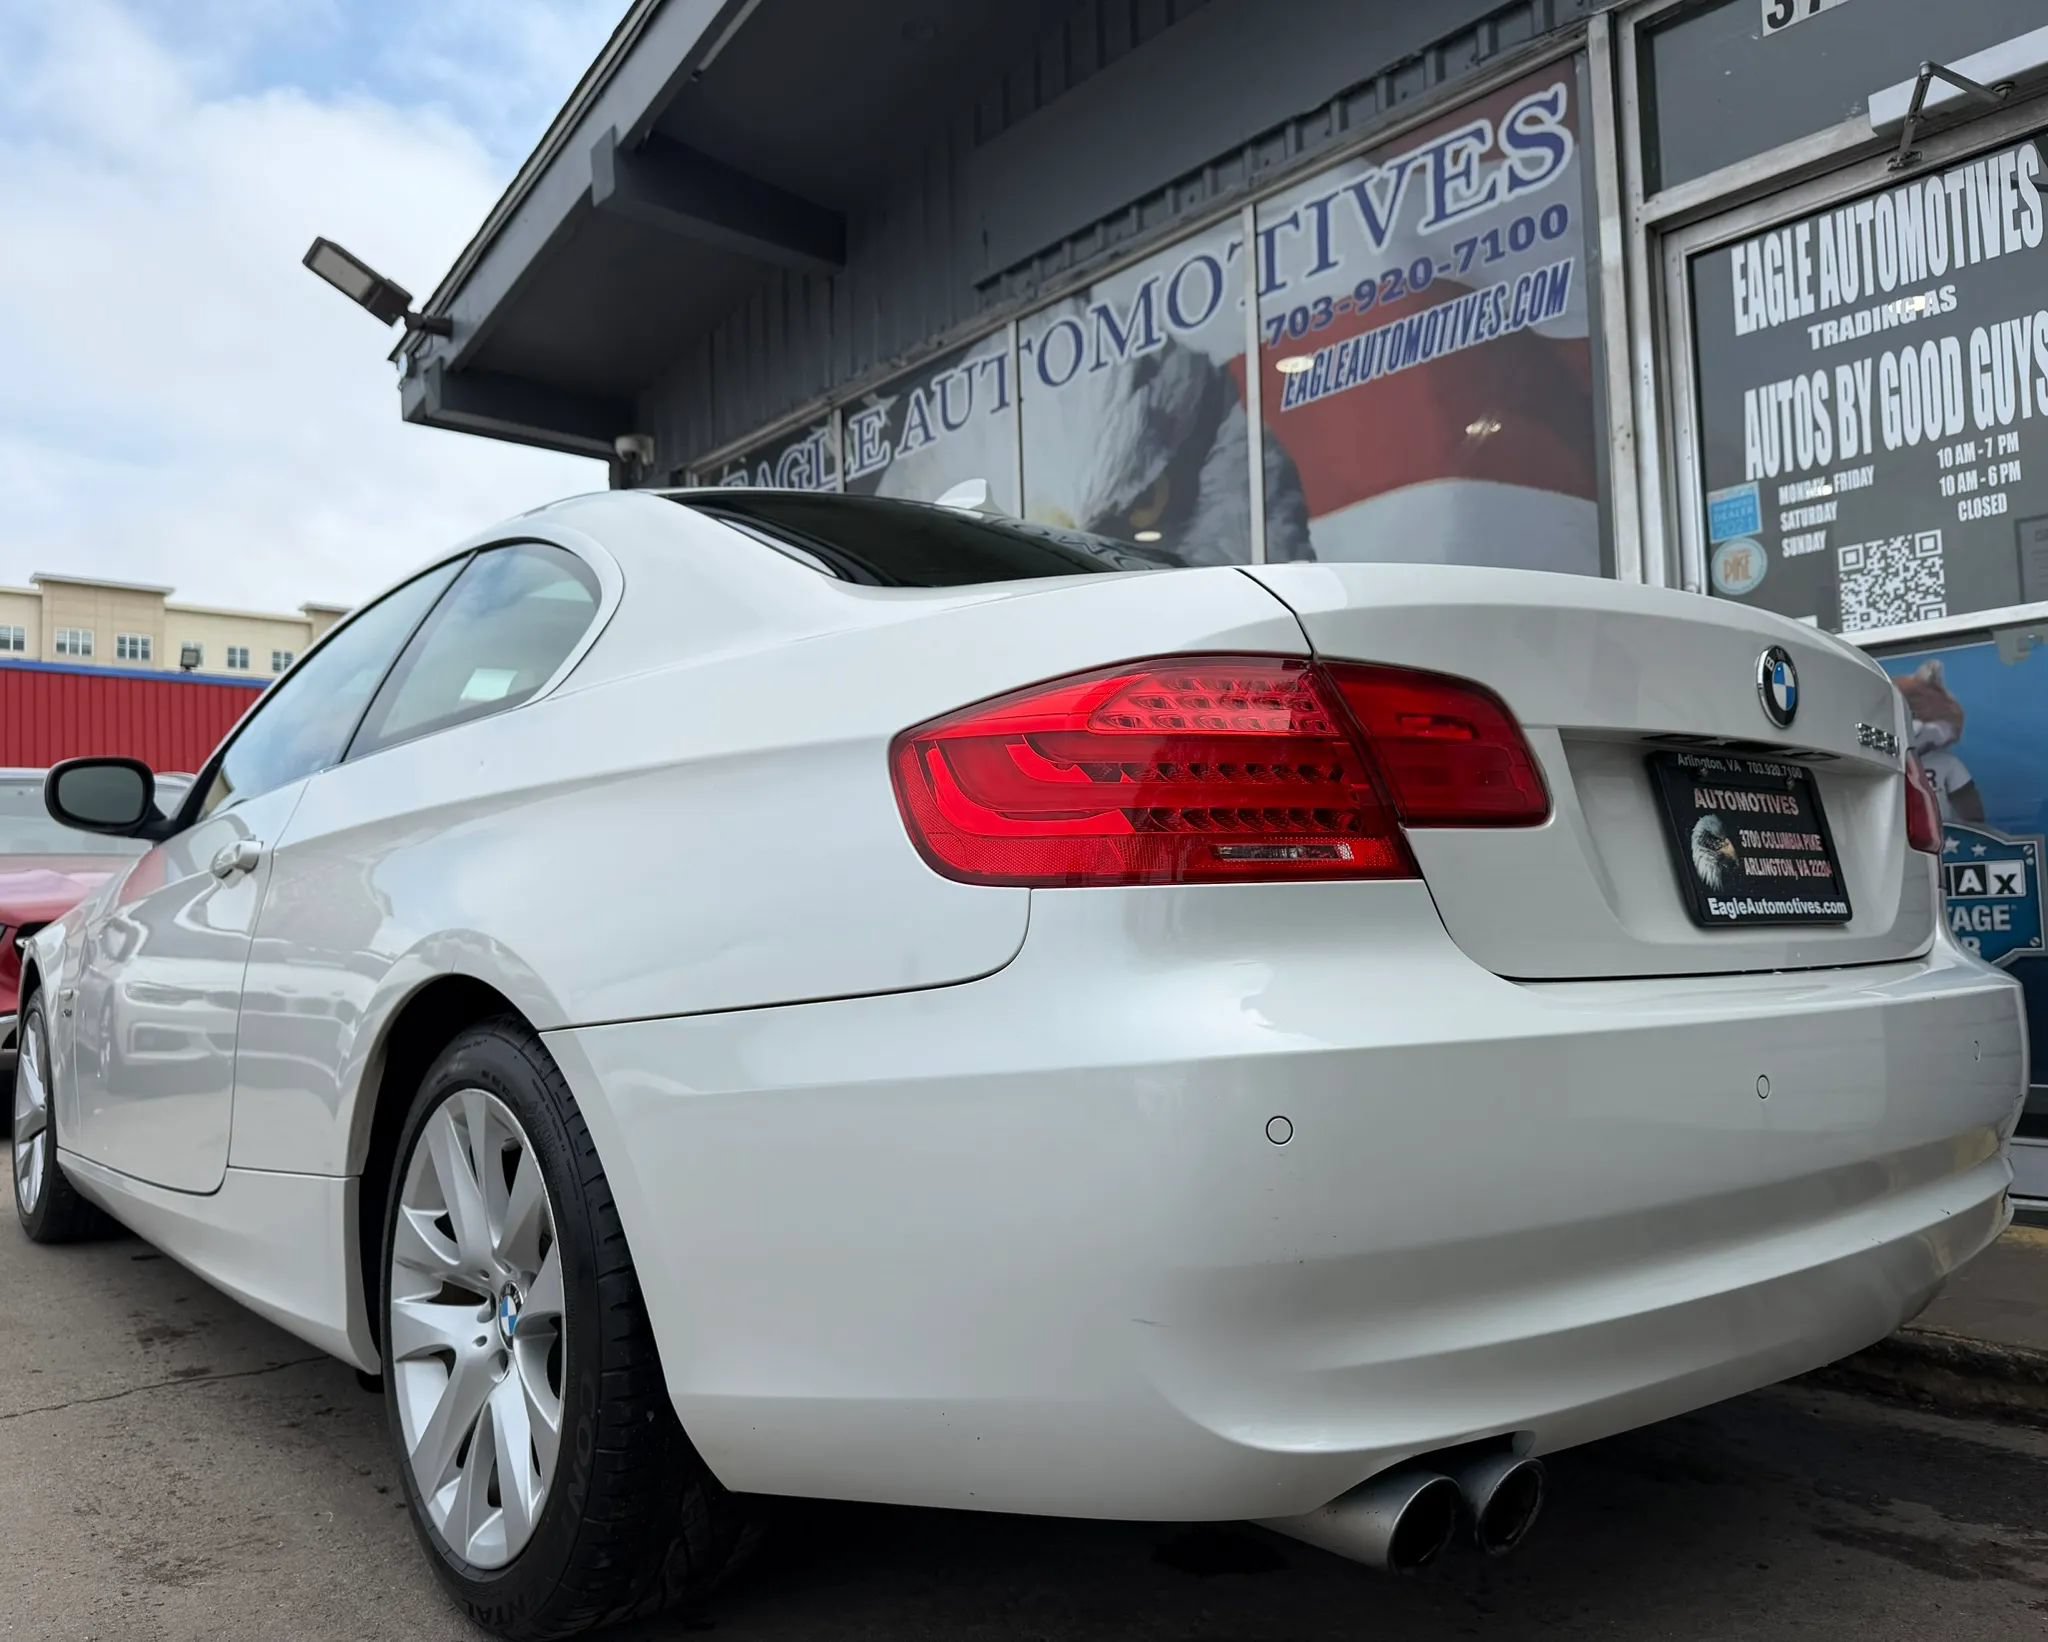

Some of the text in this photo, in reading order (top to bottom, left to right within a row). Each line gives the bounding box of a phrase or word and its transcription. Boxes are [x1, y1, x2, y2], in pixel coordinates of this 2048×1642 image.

[1730, 143, 2044, 337] EAGLE AUTOMOTIVES
[718, 82, 1574, 491] GLE AUTOMOTIVES
[1265, 203, 1569, 347] 703-920-7100
[1281, 257, 1574, 411] EAGLEAUTOMOTIVES.COM
[1808, 284, 1958, 350] TRADING AS
[1744, 310, 2048, 482] AUTOS BY GOOD GUYS
[1937, 446, 1953, 470] 10
[1955, 441, 1976, 466] AM
[1984, 437, 1993, 459] 7
[1997, 431, 2020, 456] PM
[1778, 475, 1826, 506] MONDAY
[1833, 465, 1875, 493] FRIDAY
[1939, 474, 1956, 497] 10
[1957, 469, 1978, 494] AM
[1988, 465, 1998, 487] 6
[1999, 460, 2022, 484] PM
[1780, 500, 1838, 532] SATURDAY
[1957, 492, 2008, 522] CLOSED
[1781, 529, 1827, 558] SUNDAY
[1727, 760, 1742, 772] VA
[1694, 788, 1799, 816] AUTOMOTIVES
[1744, 857, 1799, 880] ARLINGTON,
[1796, 859, 1811, 877] VA
[1707, 897, 1848, 919] EagleAutomotives.com
